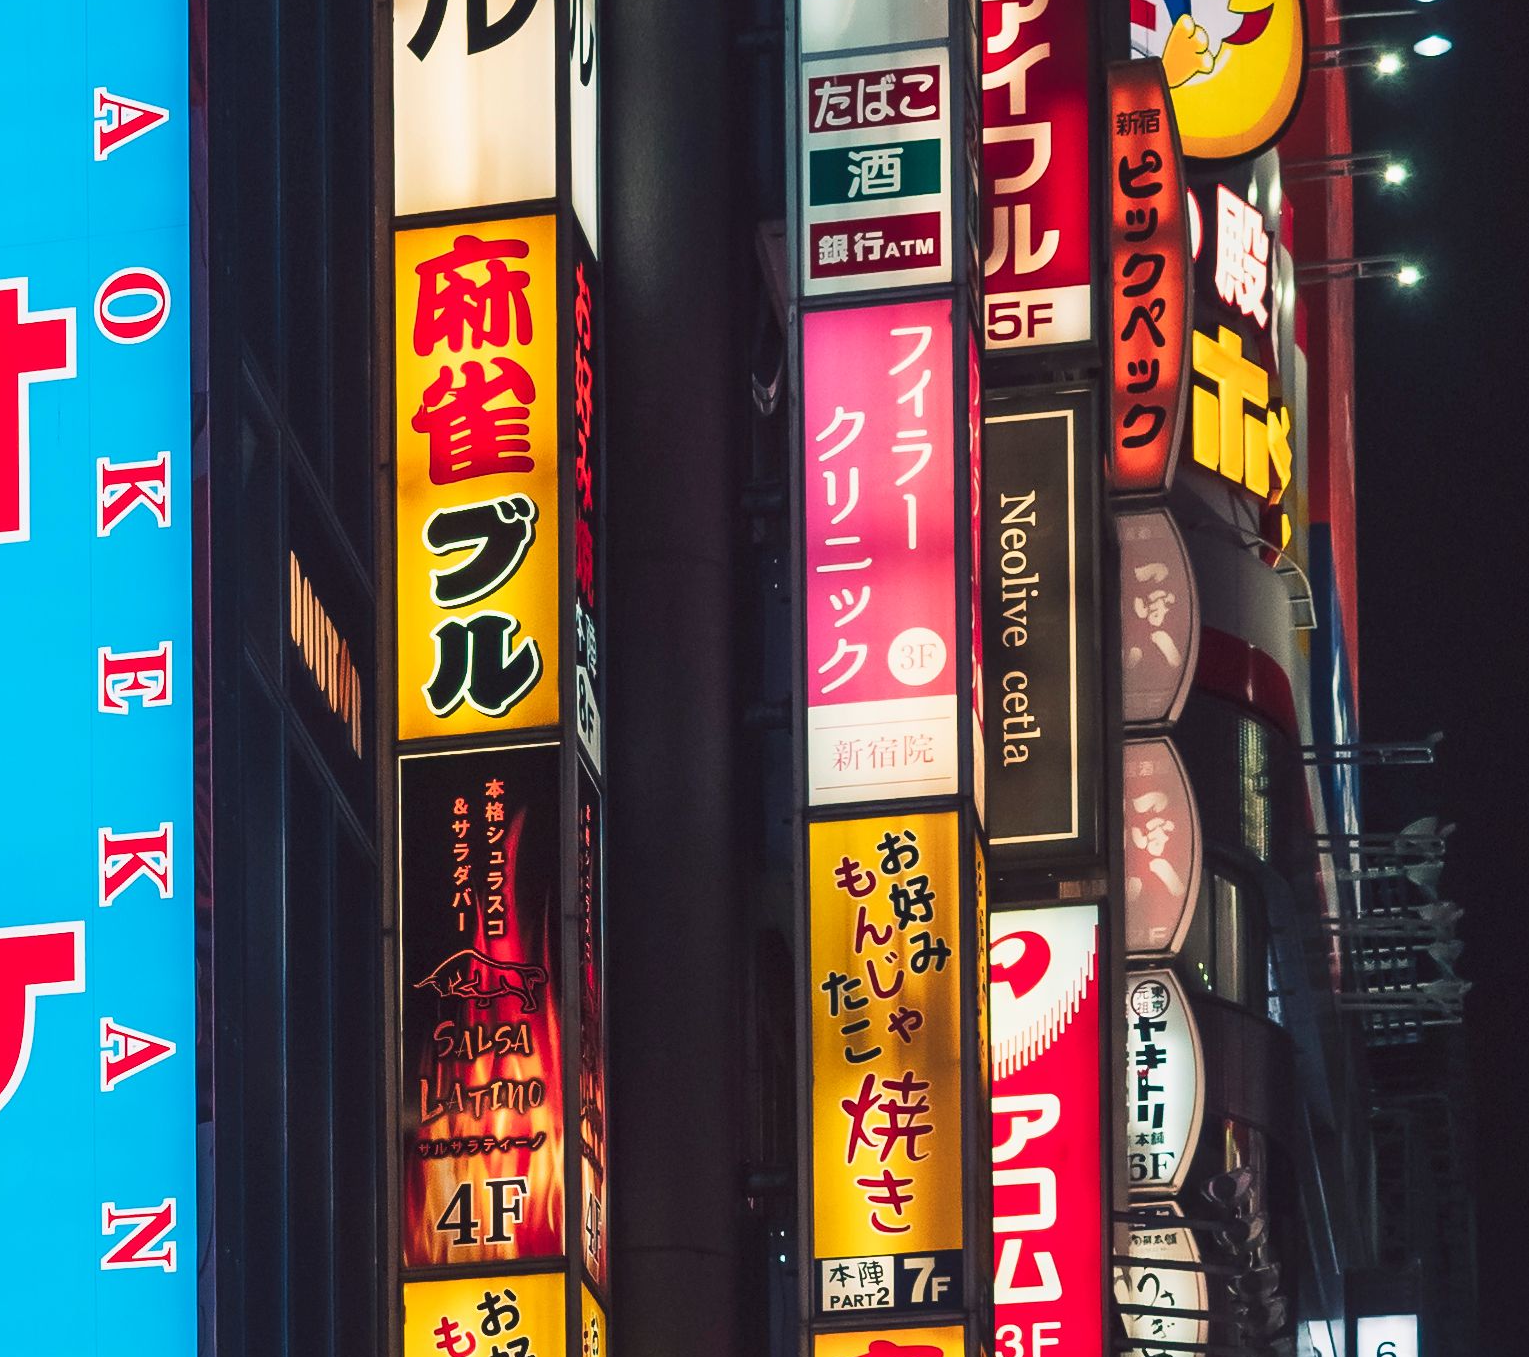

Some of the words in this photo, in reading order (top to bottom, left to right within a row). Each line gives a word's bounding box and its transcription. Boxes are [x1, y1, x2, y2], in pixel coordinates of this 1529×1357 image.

[814, 74, 937, 129] たばこ
[1117, 110, 1161, 136] 新宿
[848, 148, 904, 198] 酒
[987, 300, 1054, 342] 5F
[412, 234, 544, 720] 麻雀ブル
[888, 325, 933, 550] フィラー
[816, 406, 873, 694] クリニック
[1000, 489, 1040, 648] Neolive
[900, 642, 936, 672] 3F
[832, 733, 935, 772] 新宿院
[451, 797, 472, 933] &サラダバー
[485, 778, 505, 937] 本格シュラスコ
[876, 829, 951, 975] お好み
[833, 856, 925, 1044] もんじゃ
[822, 971, 883, 1064] たこ
[1133, 1016, 1168, 1129] ヤキトリ
[841, 1071, 934, 1235] 焼き
[991, 1092, 1063, 1306] アコム
[1129, 1152, 1175, 1181] 6F
[436, 1177, 528, 1247] 4F
[829, 1259, 885, 1289] 本陣
[903, 1257, 951, 1305] 7F
